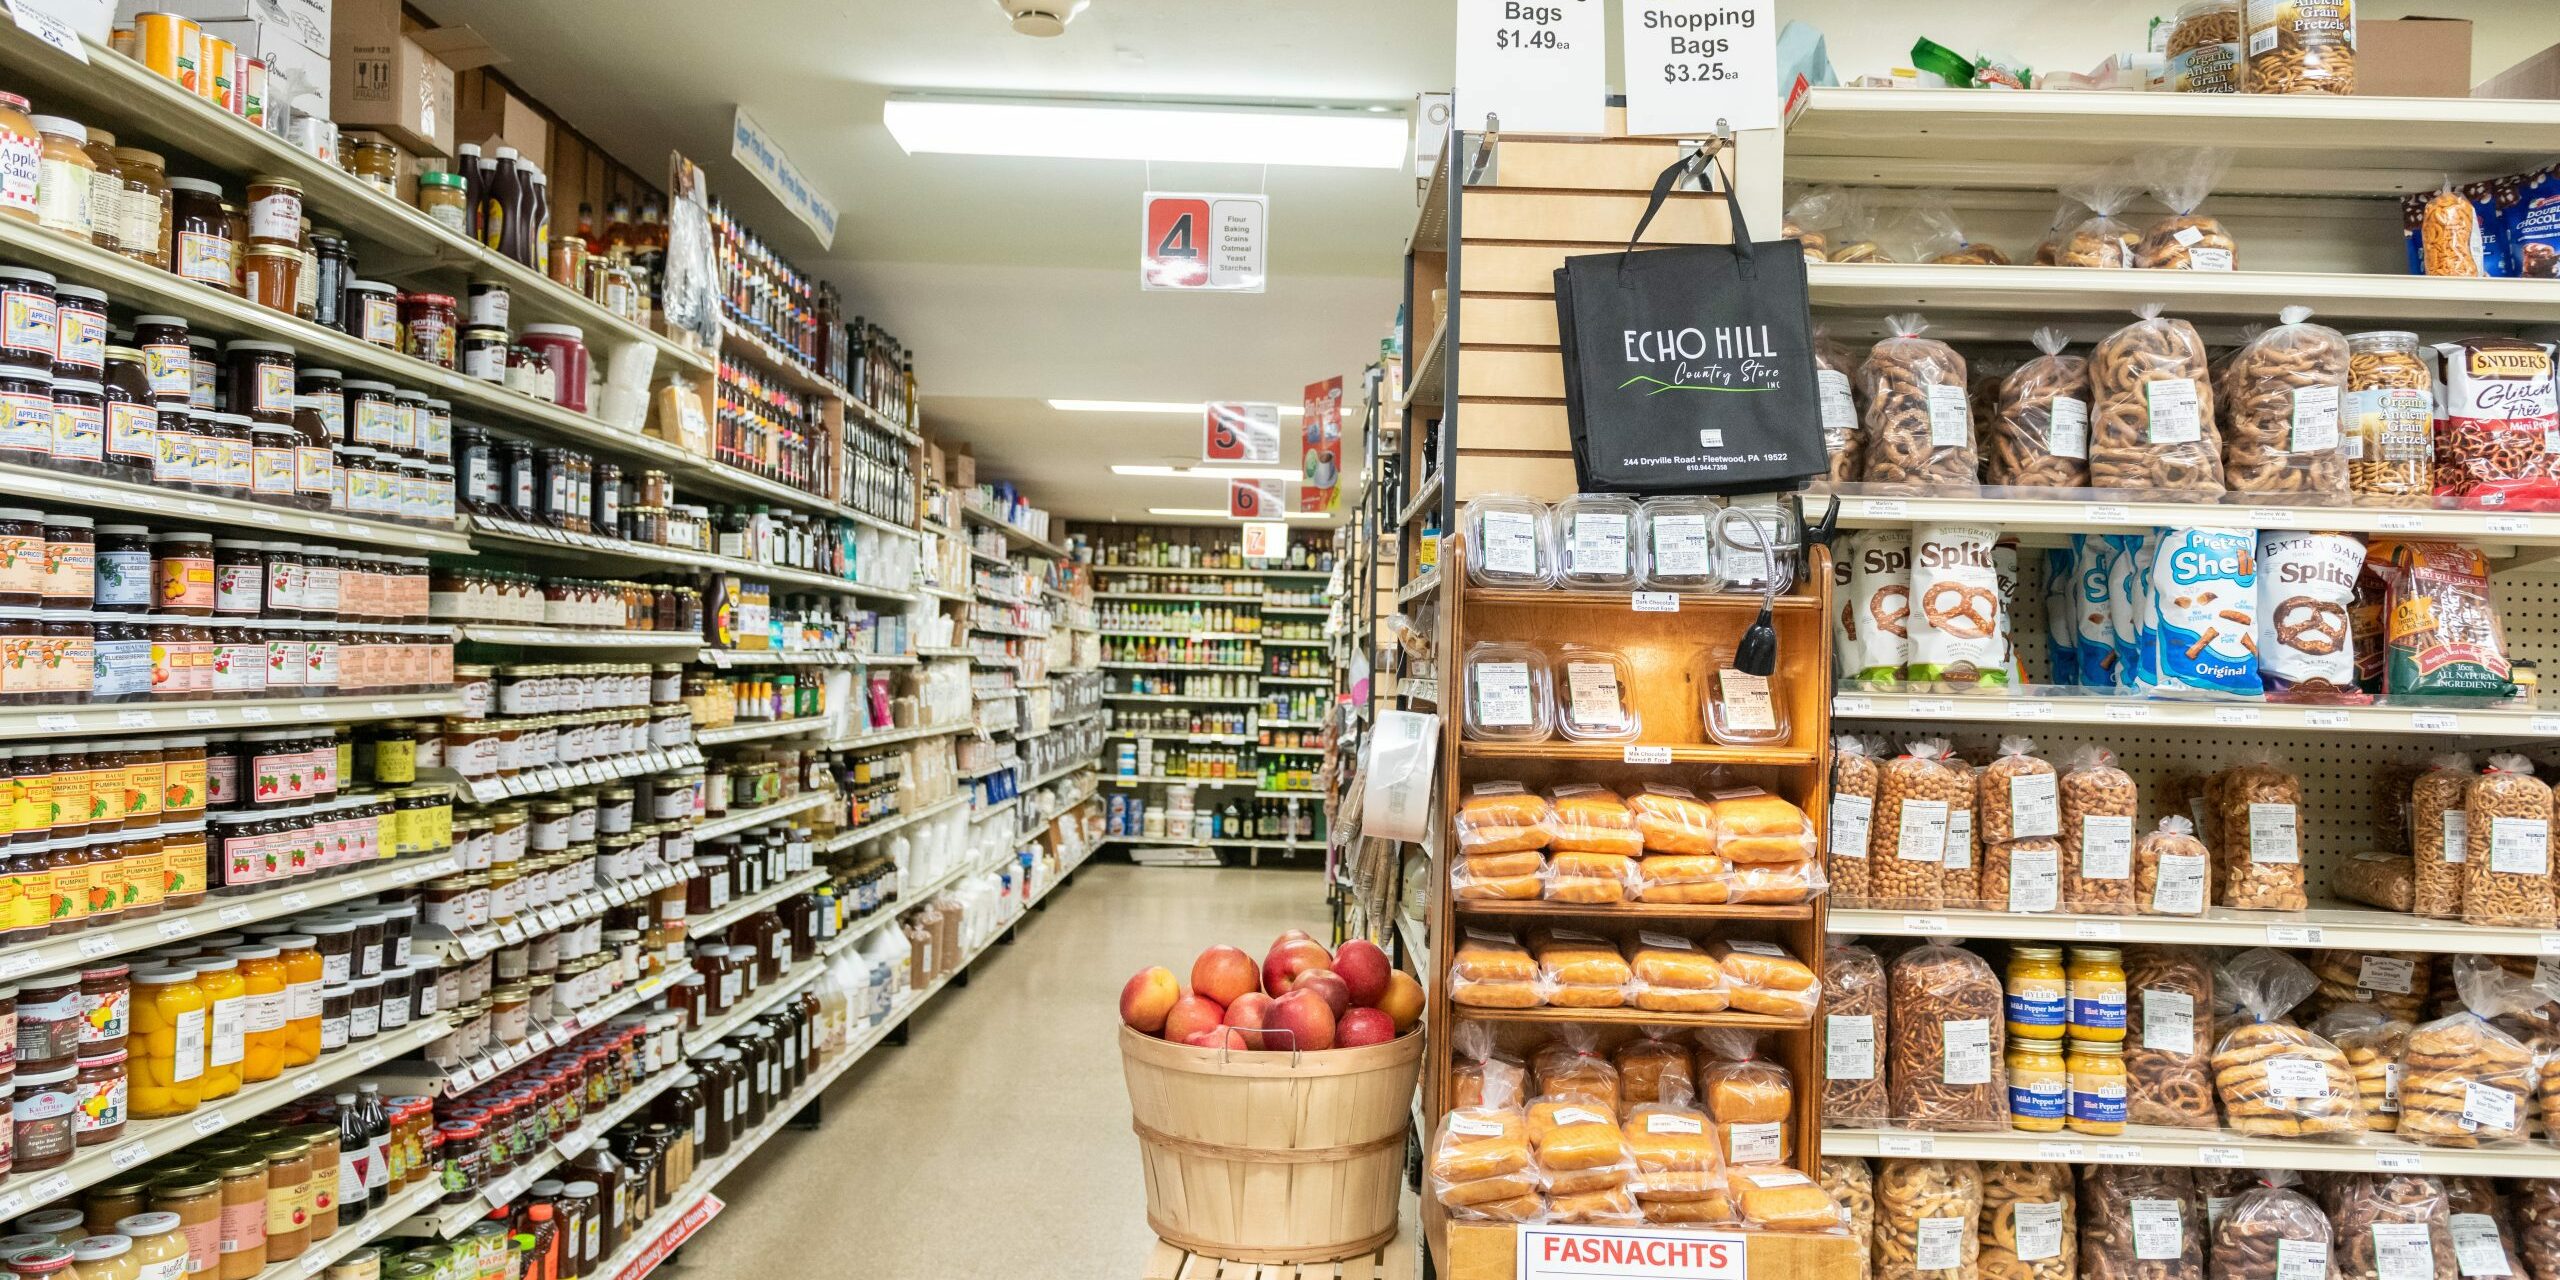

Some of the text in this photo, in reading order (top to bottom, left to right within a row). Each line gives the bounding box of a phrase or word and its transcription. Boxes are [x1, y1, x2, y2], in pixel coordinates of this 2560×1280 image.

[1504, 1, 1563, 26] Bags
[2300, 7, 2338, 19] Grain
[1643, 8, 1756, 32] Shopping
[2293, 19, 2345, 32] Pretzels
[1670, 36, 1729, 58] Bags
[2185, 51, 2233, 67] Organic
[2185, 62, 2233, 78] Ancient
[374, 82, 388, 90] UP
[2192, 74, 2227, 87] Grain
[1, 148, 36, 167] Apple
[4, 163, 37, 181] Sauce
[1227, 215, 1247, 223] Flour
[1224, 225, 1250, 234] Baking
[1158, 212, 1198, 260] 4
[1224, 235, 1249, 243] Grains
[1221, 245, 1252, 253] Oatmeal
[1226, 254, 1247, 262] Yeast
[1219, 264, 1252, 272] Starches
[1624, 325, 1777, 362] ECHO HILL
[2476, 349, 2548, 369] SNYDER'S
[1674, 359, 1780, 386] Country Store
[2378, 395, 2427, 408] Organic
[18, 410, 38, 419] APPLE
[2378, 408, 2427, 420] Ancient
[2502, 399, 2542, 420] Free
[77, 422, 91, 430] APPLE
[1216, 415, 1237, 448] 5
[2387, 421, 2422, 432] Grain
[2510, 421, 2531, 431] Mini
[2380, 433, 2427, 445] Pretzels
[1624, 453, 1788, 466] 244 Dryville Road Fleetwood, PA 19522
[1237, 487, 1253, 509] 6
[1251, 531, 1262, 549] 7
[2192, 534, 2250, 550] Pretzel
[2279, 560, 2354, 589] Splits
[2453, 576, 2481, 586] STICKS
[2196, 664, 2247, 678] Original
[2437, 671, 2498, 681] ALL NATURAL
[2438, 680, 2498, 690] INGREDIENTS
[126, 867, 152, 875] PUMPKIN
[2010, 1001, 2047, 1014] Mild Pepper
[2099, 1008, 2119, 1017] Pepper
[105, 1028, 121, 1037] EDEN
[2016, 1095, 2054, 1106] Mild Pepper
[2099, 1102, 2119, 1111] Pepper
[100, 1117, 117, 1126] EDEN
[28, 1136, 63, 1147] Apple Butter
[1543, 1236, 1728, 1269] FASNACHTS
